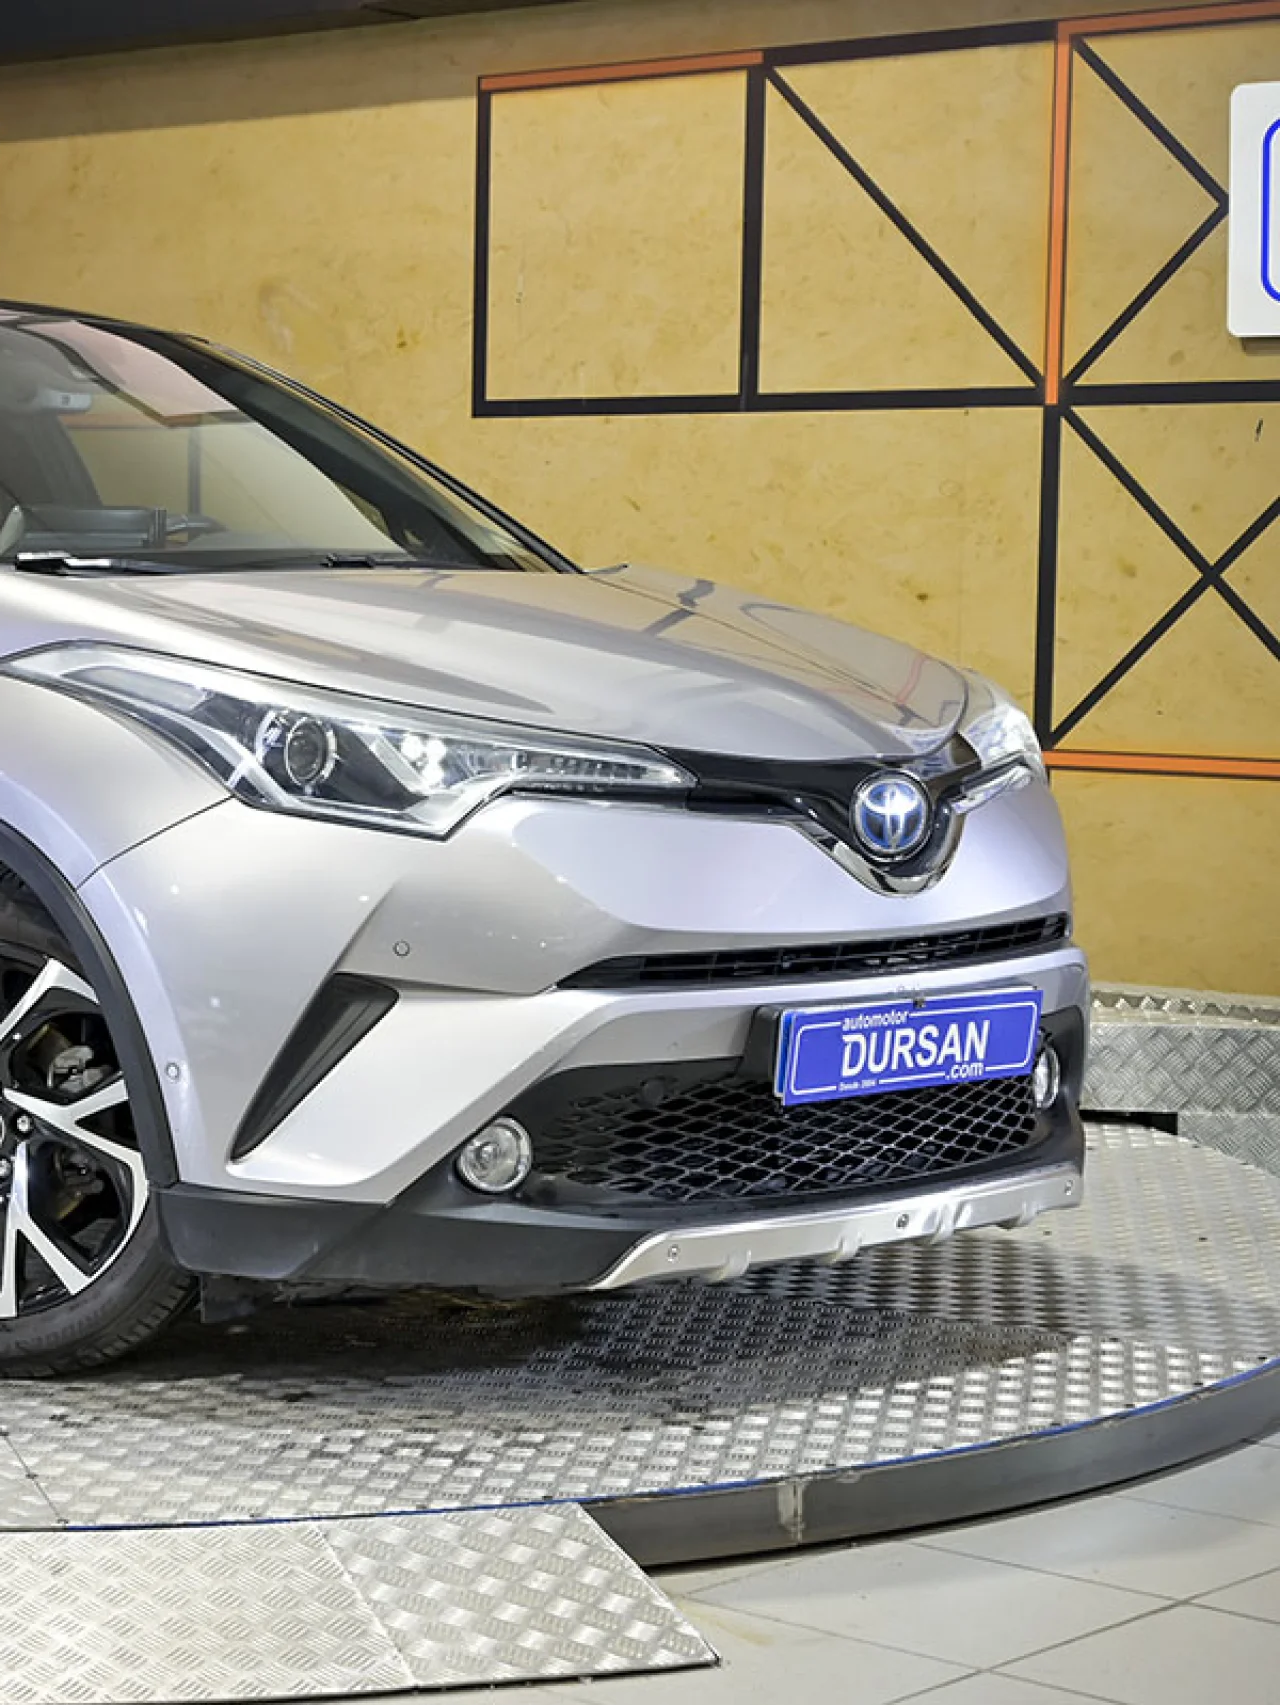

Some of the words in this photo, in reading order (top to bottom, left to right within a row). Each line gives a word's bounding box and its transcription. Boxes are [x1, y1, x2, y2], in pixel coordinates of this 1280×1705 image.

[841, 1009, 909, 1031] automotor
[841, 1019, 990, 1077] DURSAN
[944, 1061, 985, 1080] .com
